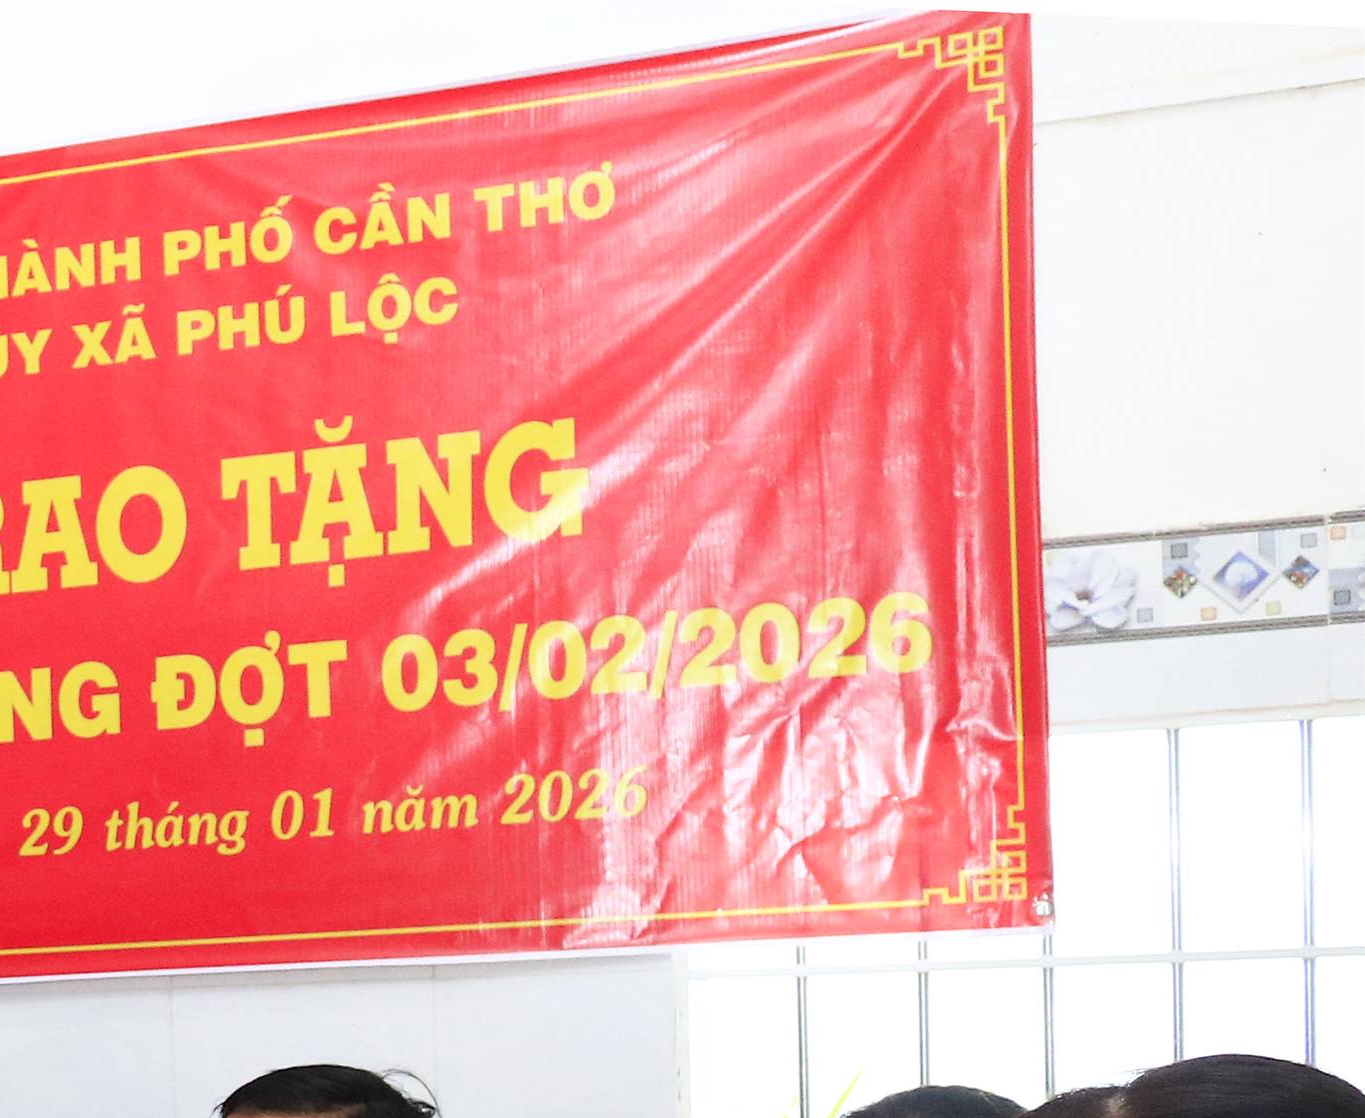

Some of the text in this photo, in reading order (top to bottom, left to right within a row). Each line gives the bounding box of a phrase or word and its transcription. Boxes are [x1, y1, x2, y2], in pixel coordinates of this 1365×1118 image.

[165, 197, 292, 274] PHỐ
[315, 184, 450, 253] CẦN
[475, 162, 614, 230] THƠ
[74, 305, 154, 367] XÃ
[178, 286, 304, 354] PHÚ
[331, 274, 457, 342] LỘC
[222, 416, 587, 586] TẶNG
[152, 632, 346, 745] ĐỢT
[383, 593, 932, 710] 03/02/2026
[21, 808, 82, 854] 29
[108, 803, 247, 854] tháng
[273, 790, 331, 839] 01
[364, 789, 476, 832] năm
[502, 769, 646, 823] 2026
